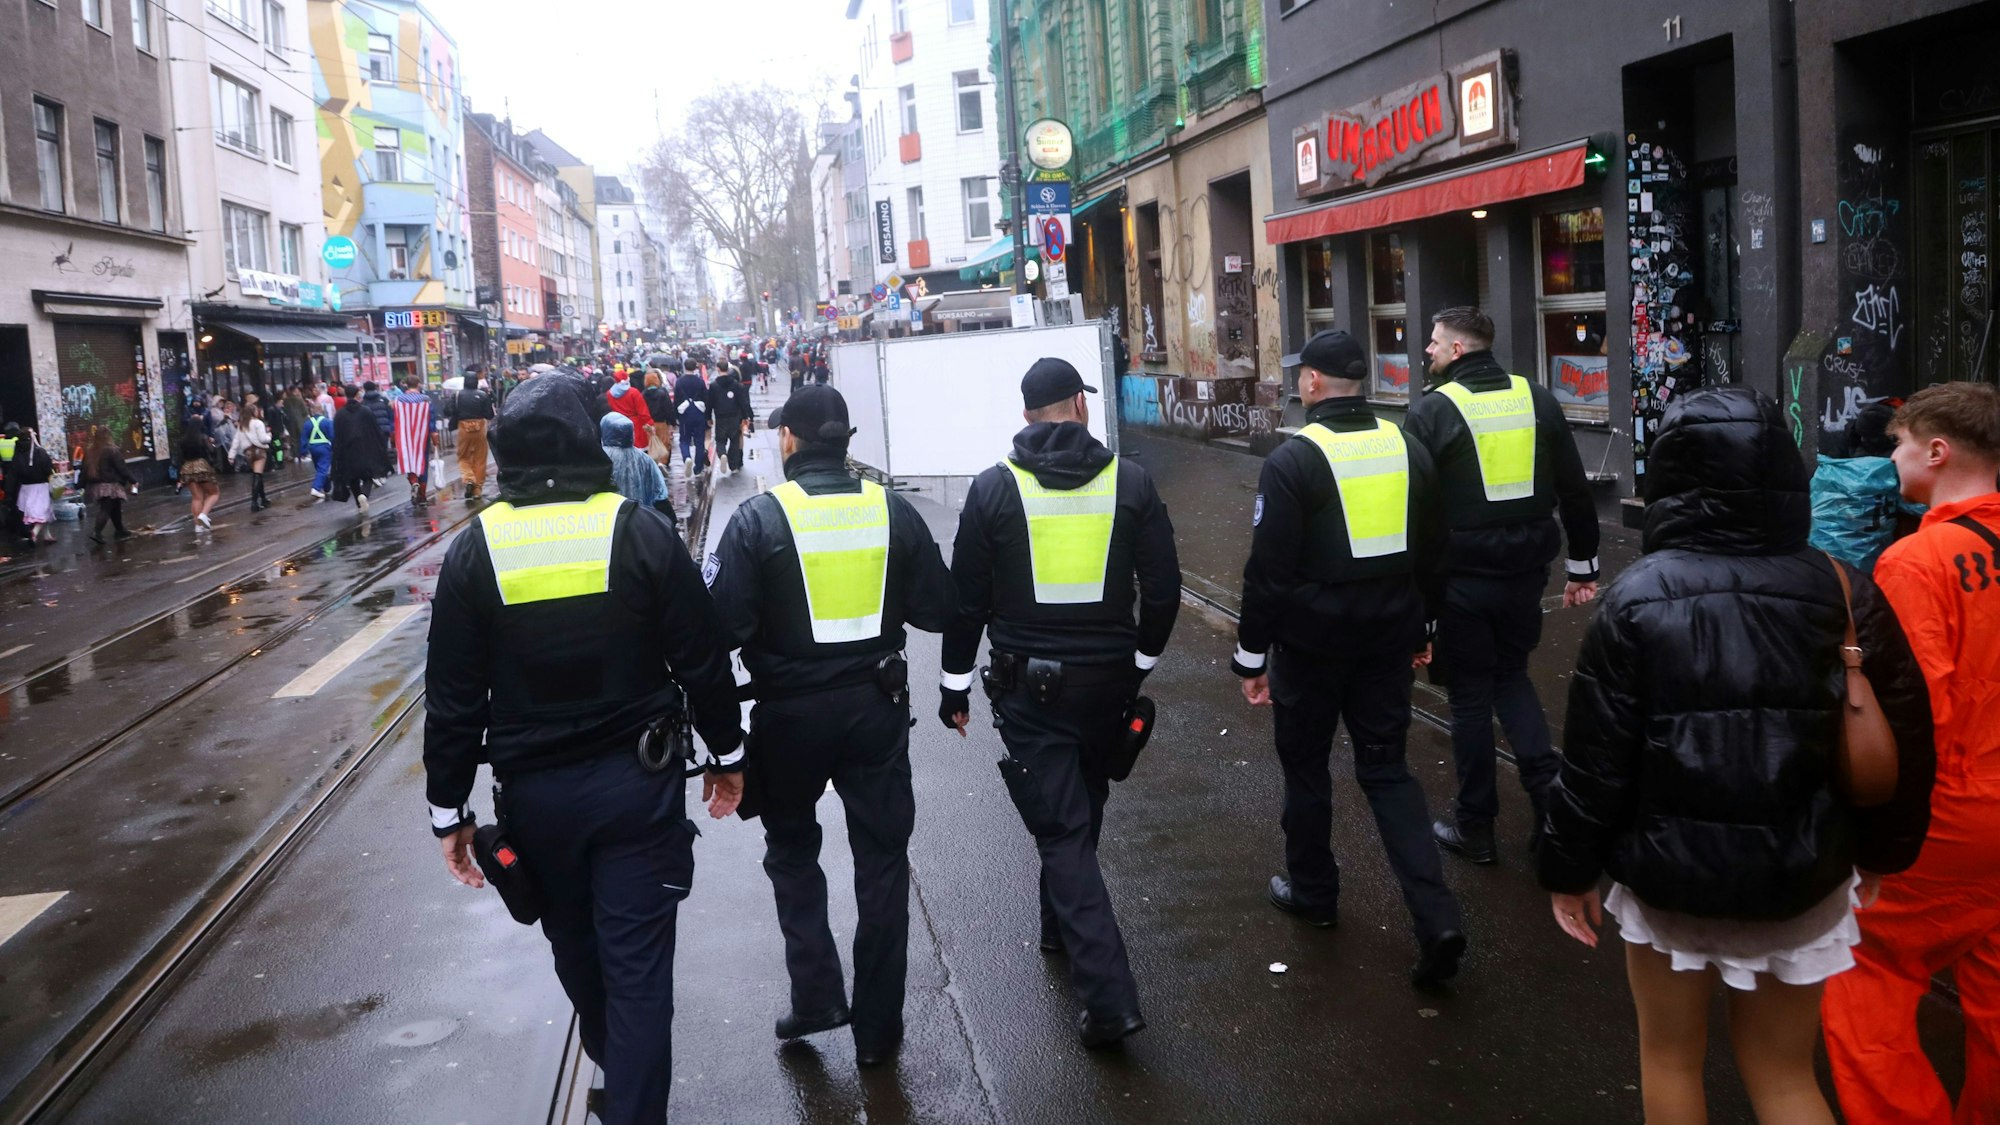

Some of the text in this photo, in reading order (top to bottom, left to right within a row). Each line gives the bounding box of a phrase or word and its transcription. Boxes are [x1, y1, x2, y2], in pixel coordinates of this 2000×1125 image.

[1662, 15, 1681, 42] 11
[1327, 85, 1443, 178] UMBRUCH
[881, 202, 893, 261] BORSALINO
[937, 311, 976, 321] BORSALINO
[1464, 397, 1531, 417] ORDNUNGSAMT
[1327, 436, 1401, 458] ORDNUNGSAMT
[491, 513, 608, 545] ORDNUNGSAMT
[796, 505, 884, 529] ORDNUNGSAMT
